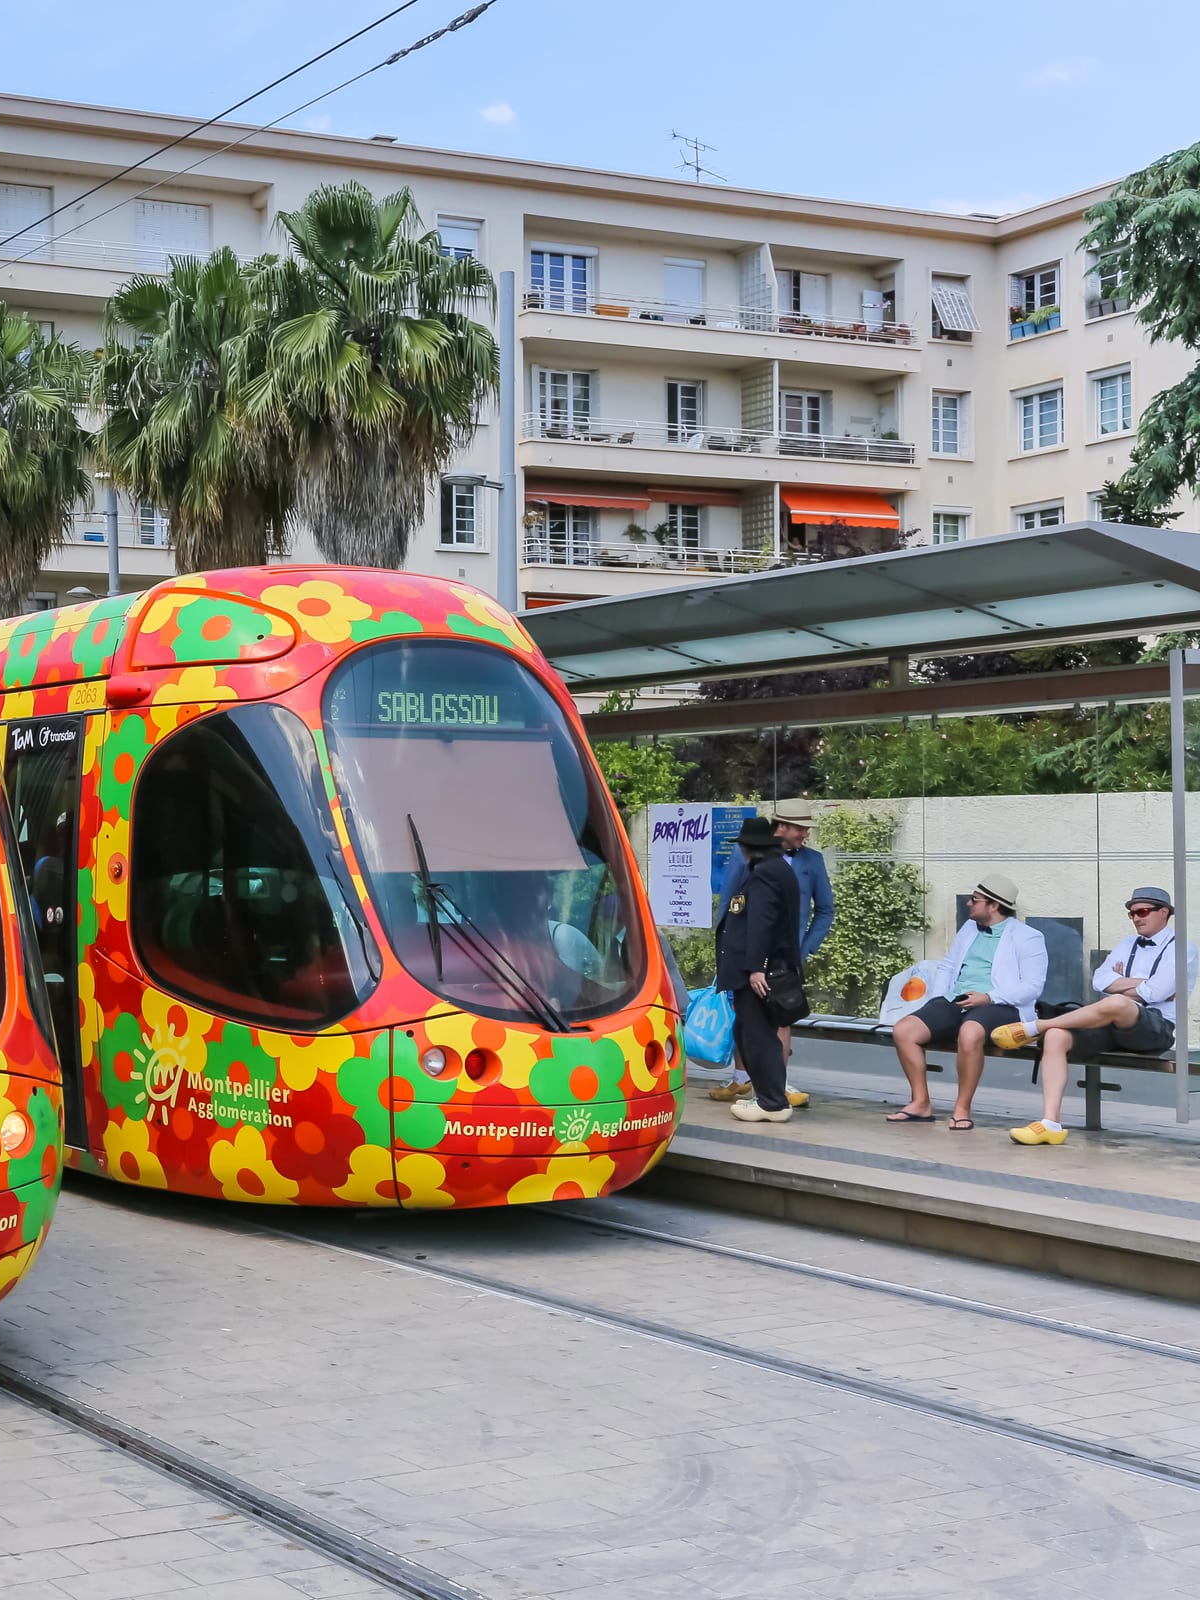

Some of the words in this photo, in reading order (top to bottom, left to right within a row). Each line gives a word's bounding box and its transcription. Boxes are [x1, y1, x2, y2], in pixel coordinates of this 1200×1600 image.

[75, 687, 98, 705] 2063
[378, 691, 499, 725] SABLASSOU
[652, 819, 682, 845] BORN
[682, 813, 710, 843] TRILL
[187, 1071, 290, 1104] Montpellier
[188, 1096, 293, 1128] Agglomération
[444, 1120, 555, 1141] Montpellier
[590, 1110, 674, 1138] Agglomération
